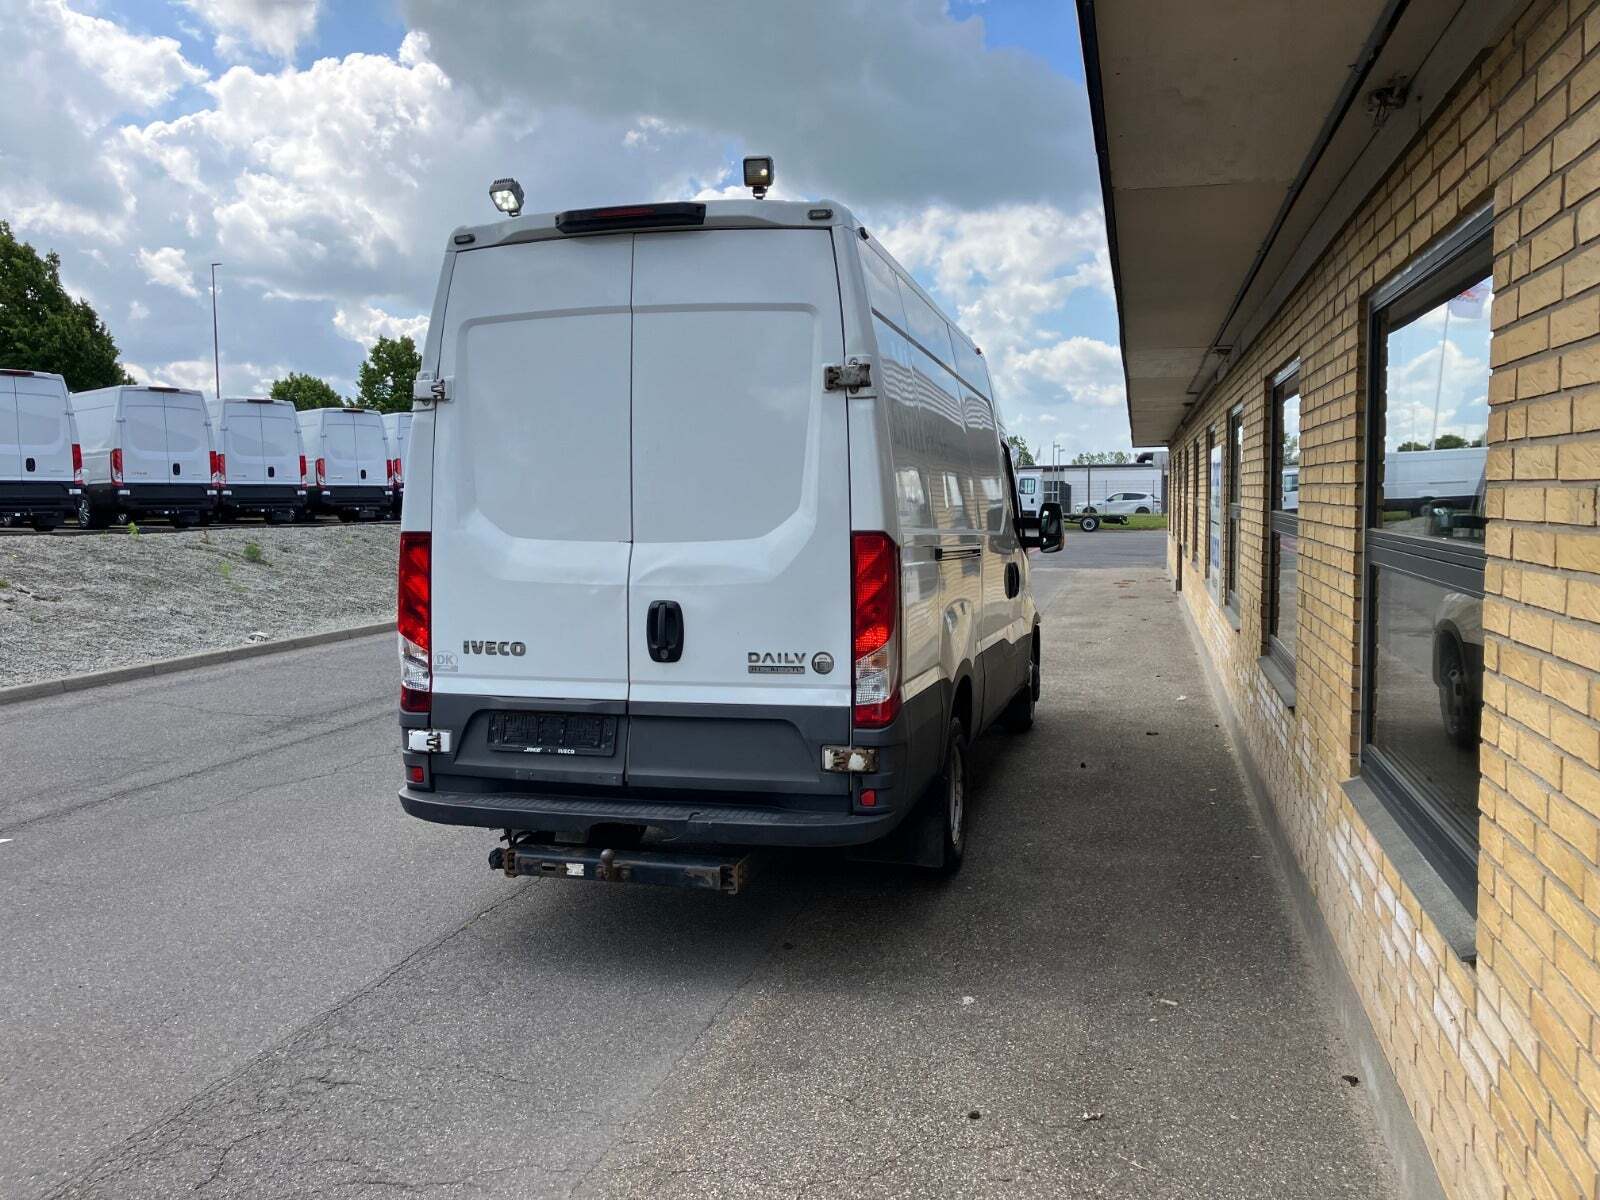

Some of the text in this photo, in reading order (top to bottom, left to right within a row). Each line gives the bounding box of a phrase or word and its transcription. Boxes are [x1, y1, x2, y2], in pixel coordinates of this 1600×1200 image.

[463, 640, 526, 656] IVECO
[436, 655, 453, 665] DK
[748, 652, 806, 664] DAILY
